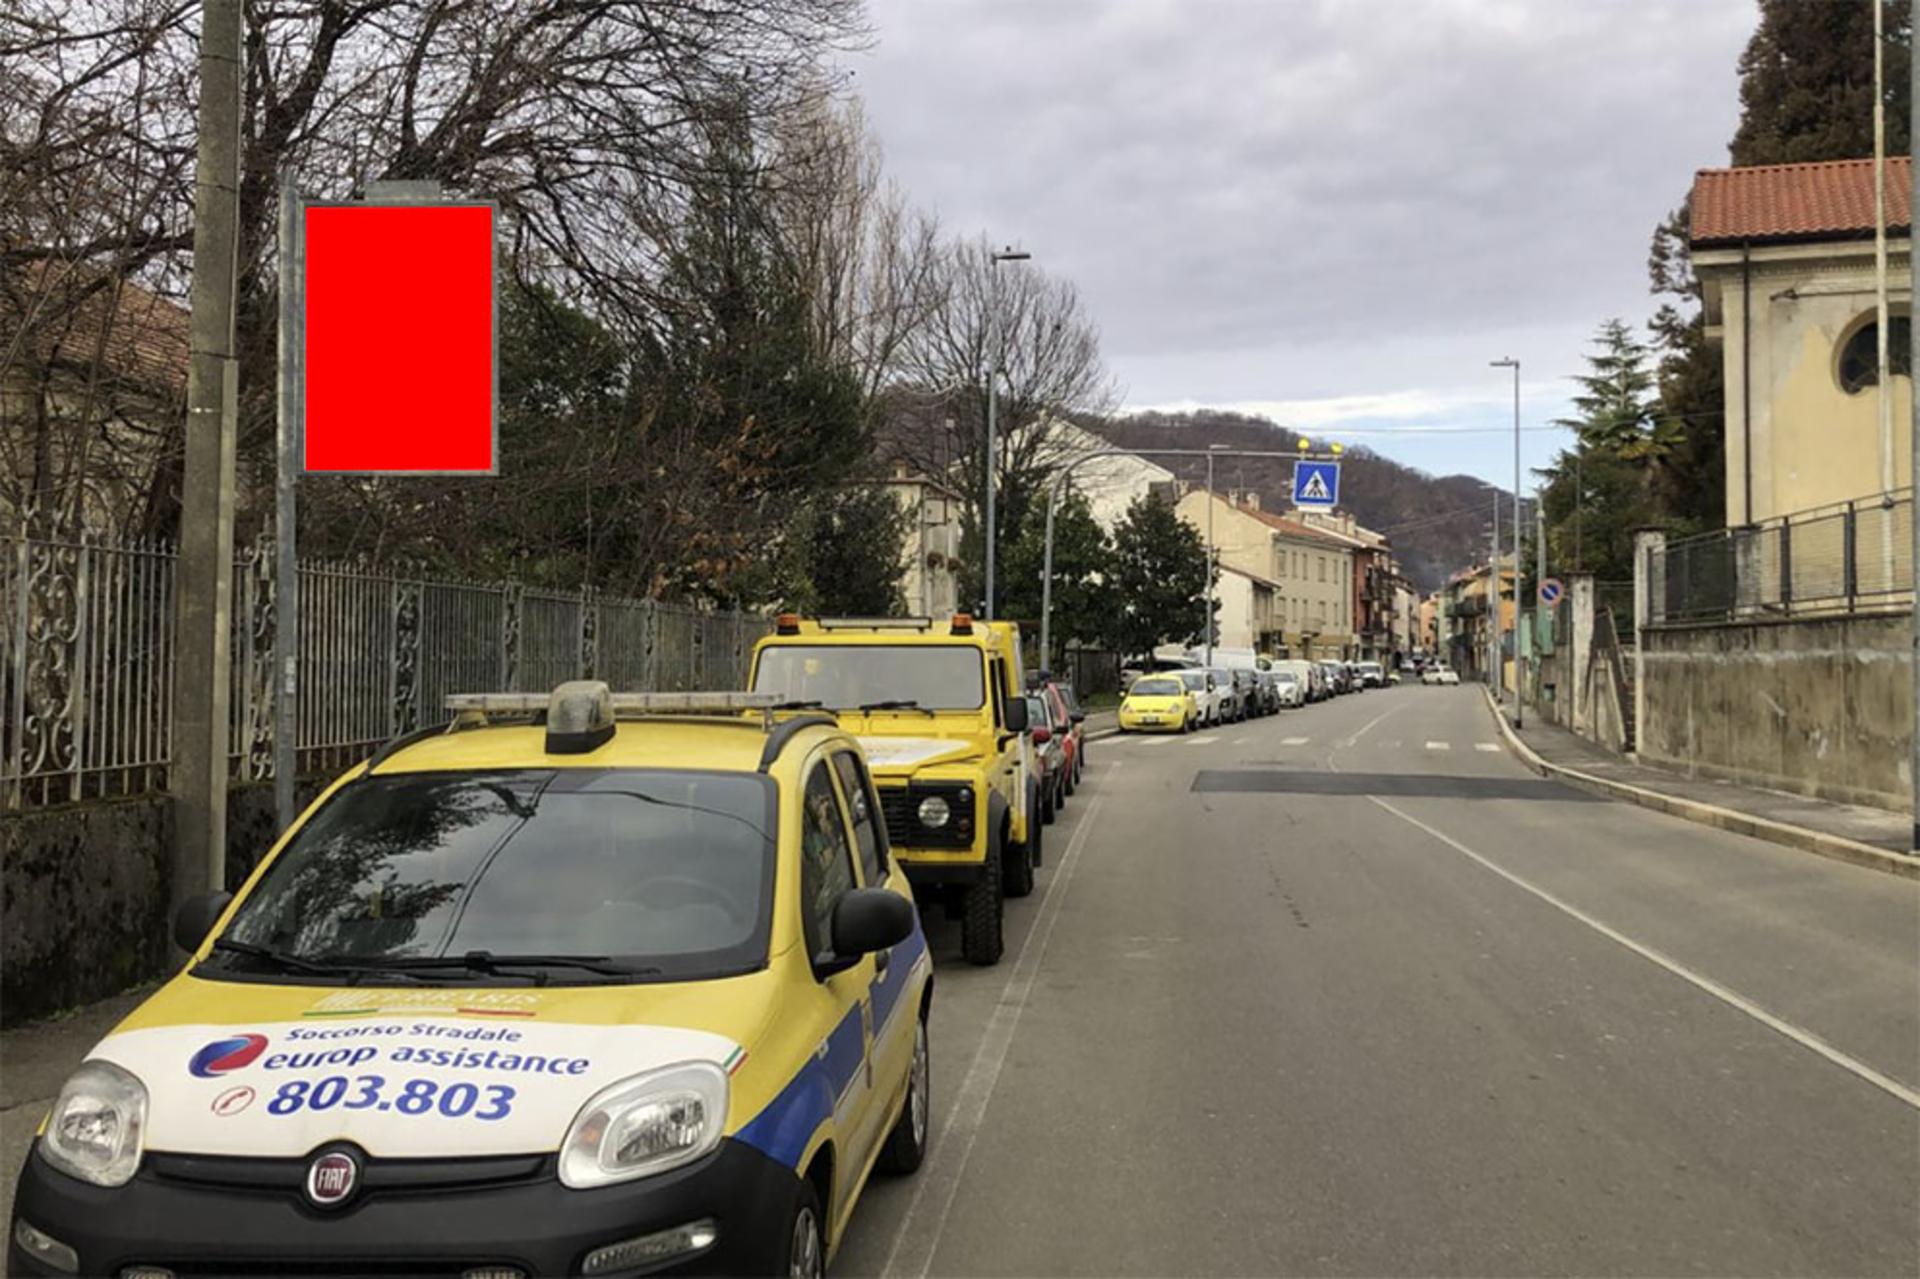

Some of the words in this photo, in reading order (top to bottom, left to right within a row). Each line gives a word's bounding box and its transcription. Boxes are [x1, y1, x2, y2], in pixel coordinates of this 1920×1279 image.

[285, 1025, 403, 1042] Soccorso
[411, 1023, 523, 1043] Stradale
[263, 1045, 379, 1070] europ
[390, 1046, 590, 1075] assistance
[267, 1075, 516, 1120] 803.803
[317, 1167, 347, 1191] FIAT
